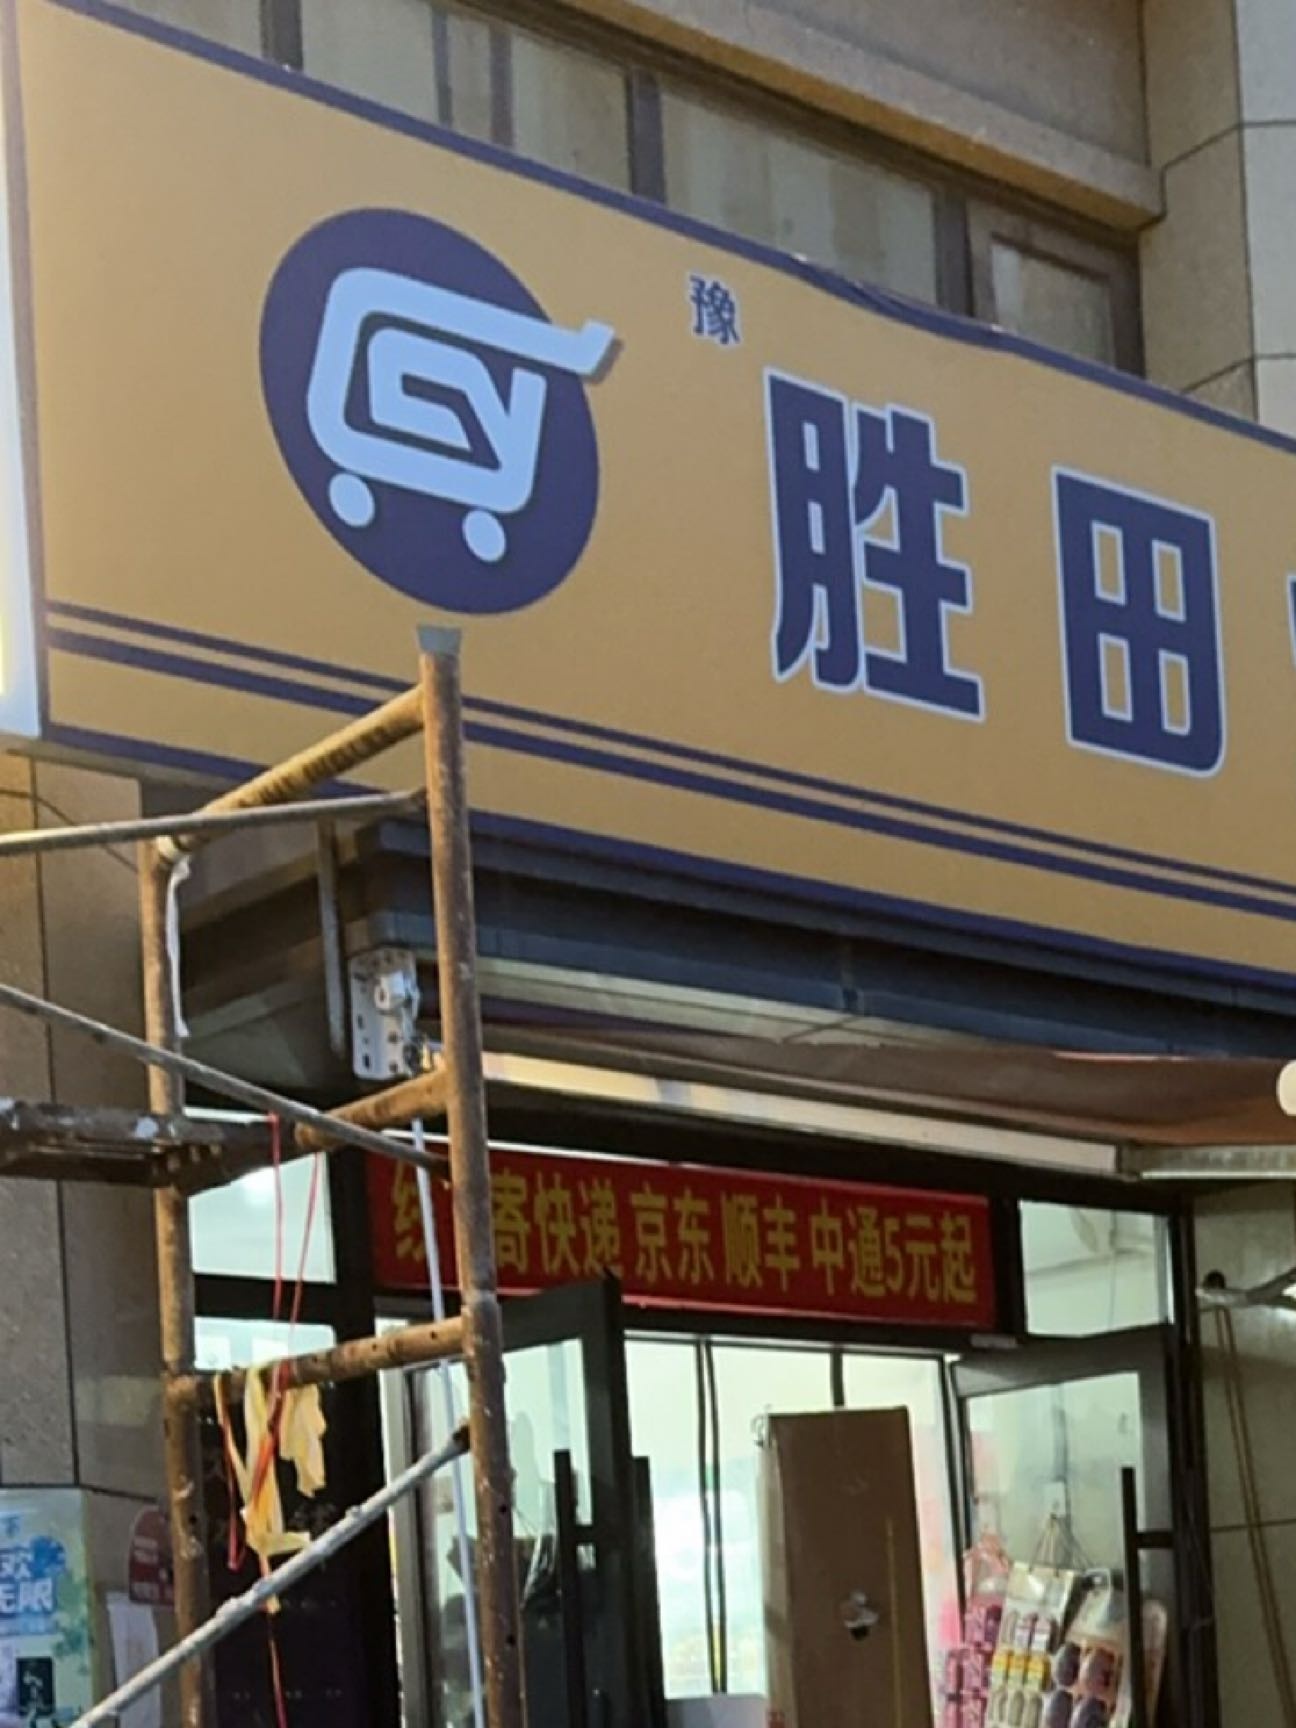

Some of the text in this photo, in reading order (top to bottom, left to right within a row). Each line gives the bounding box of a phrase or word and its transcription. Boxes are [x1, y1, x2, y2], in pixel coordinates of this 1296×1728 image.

[688, 272, 741, 345] 豫
[393, 1158, 977, 1303] 寄快递 京东 顺丰 中通5元起
